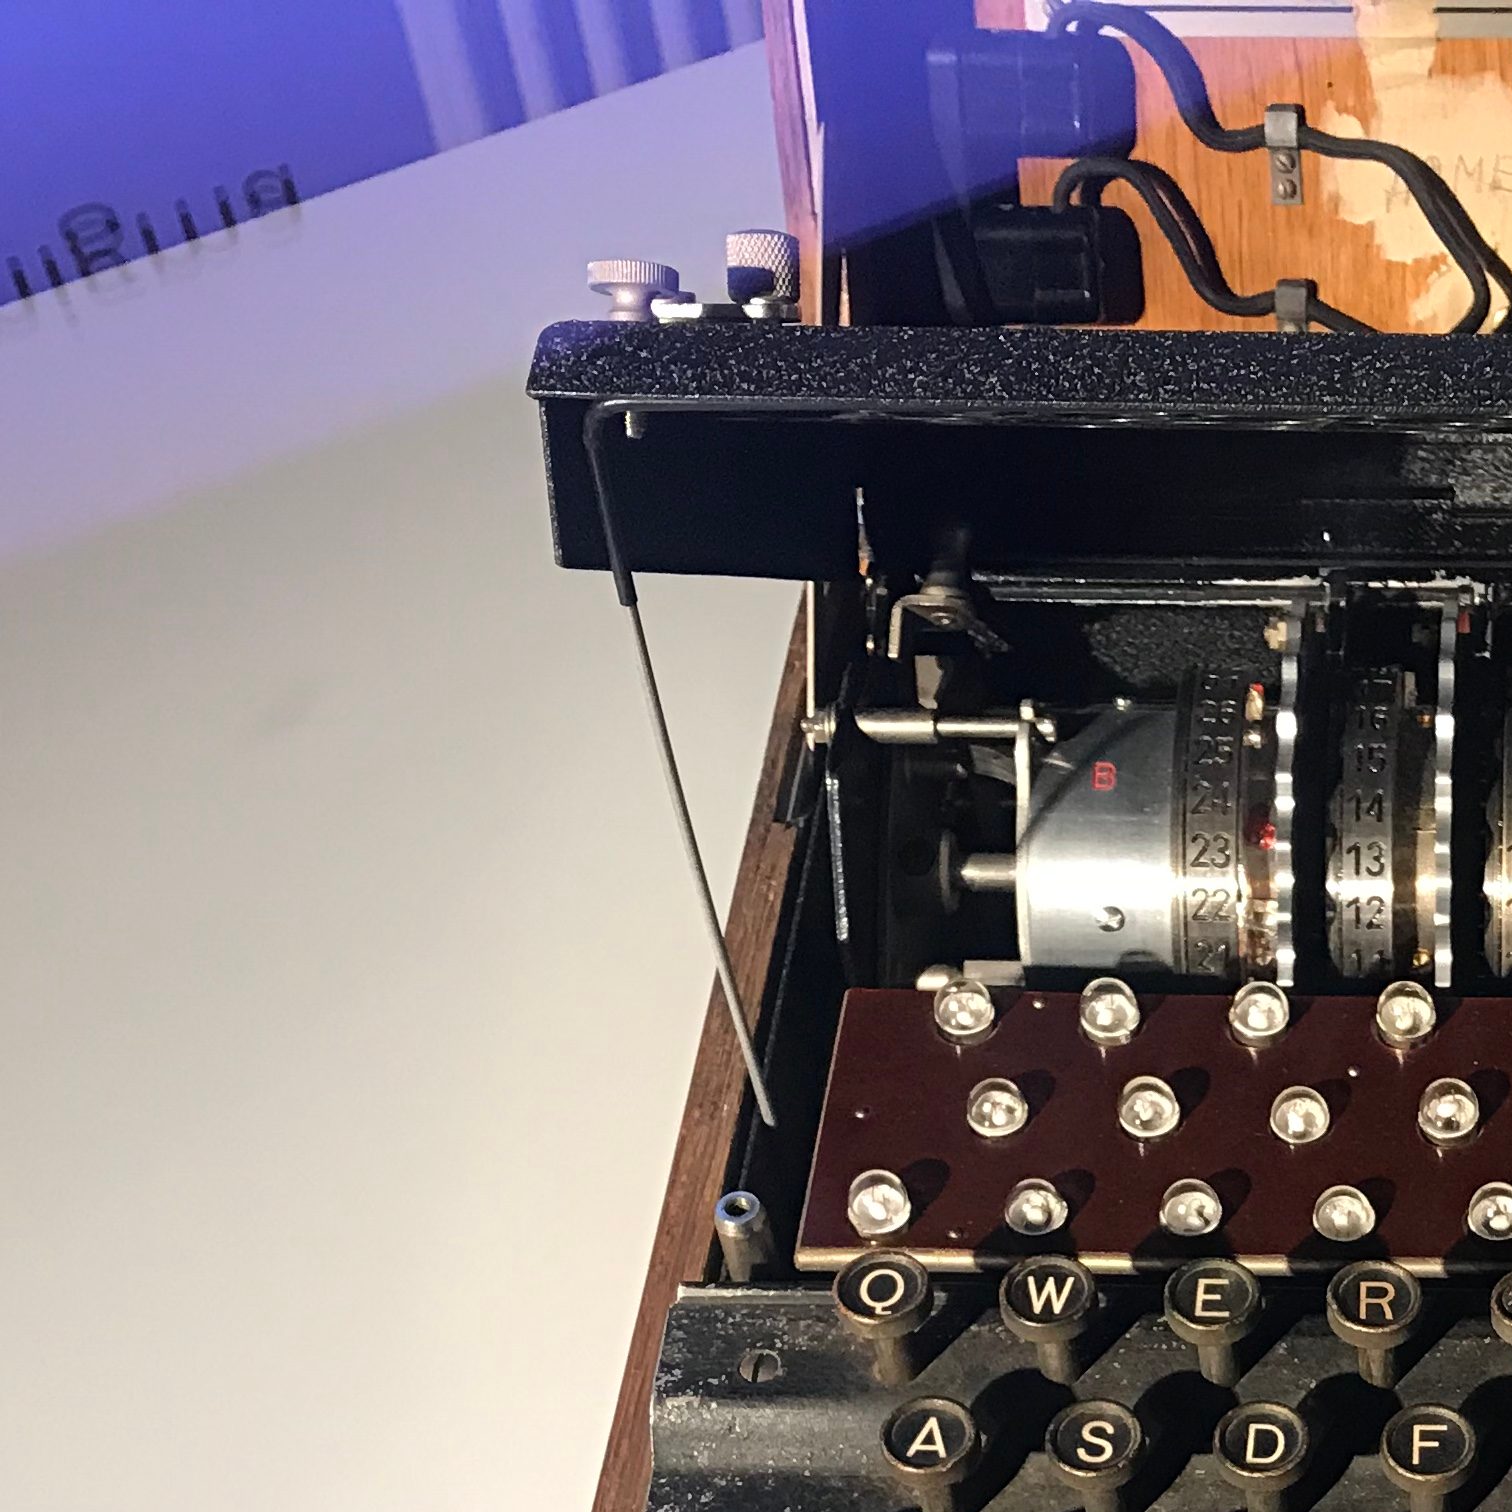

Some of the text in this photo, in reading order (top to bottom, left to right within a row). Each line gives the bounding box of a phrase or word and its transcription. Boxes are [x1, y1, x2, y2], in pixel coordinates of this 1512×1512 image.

[1092, 760, 1117, 791] B
[1356, 743, 1387, 773] 15
[1347, 788, 1384, 823] 14
[1189, 832, 1232, 869] 23
[1346, 841, 1385, 877] 13
[1191, 888, 1232, 922] 22
[1346, 896, 1386, 930] 12
[859, 1268, 905, 1316] Q
[1027, 1275, 1075, 1315] W
[1194, 1278, 1230, 1318] E
[1359, 1281, 1396, 1321] R
[906, 1416, 947, 1459] A
[1076, 1420, 1115, 1463] S
[1245, 1423, 1286, 1464] D
[1412, 1424, 1448, 1465] F
